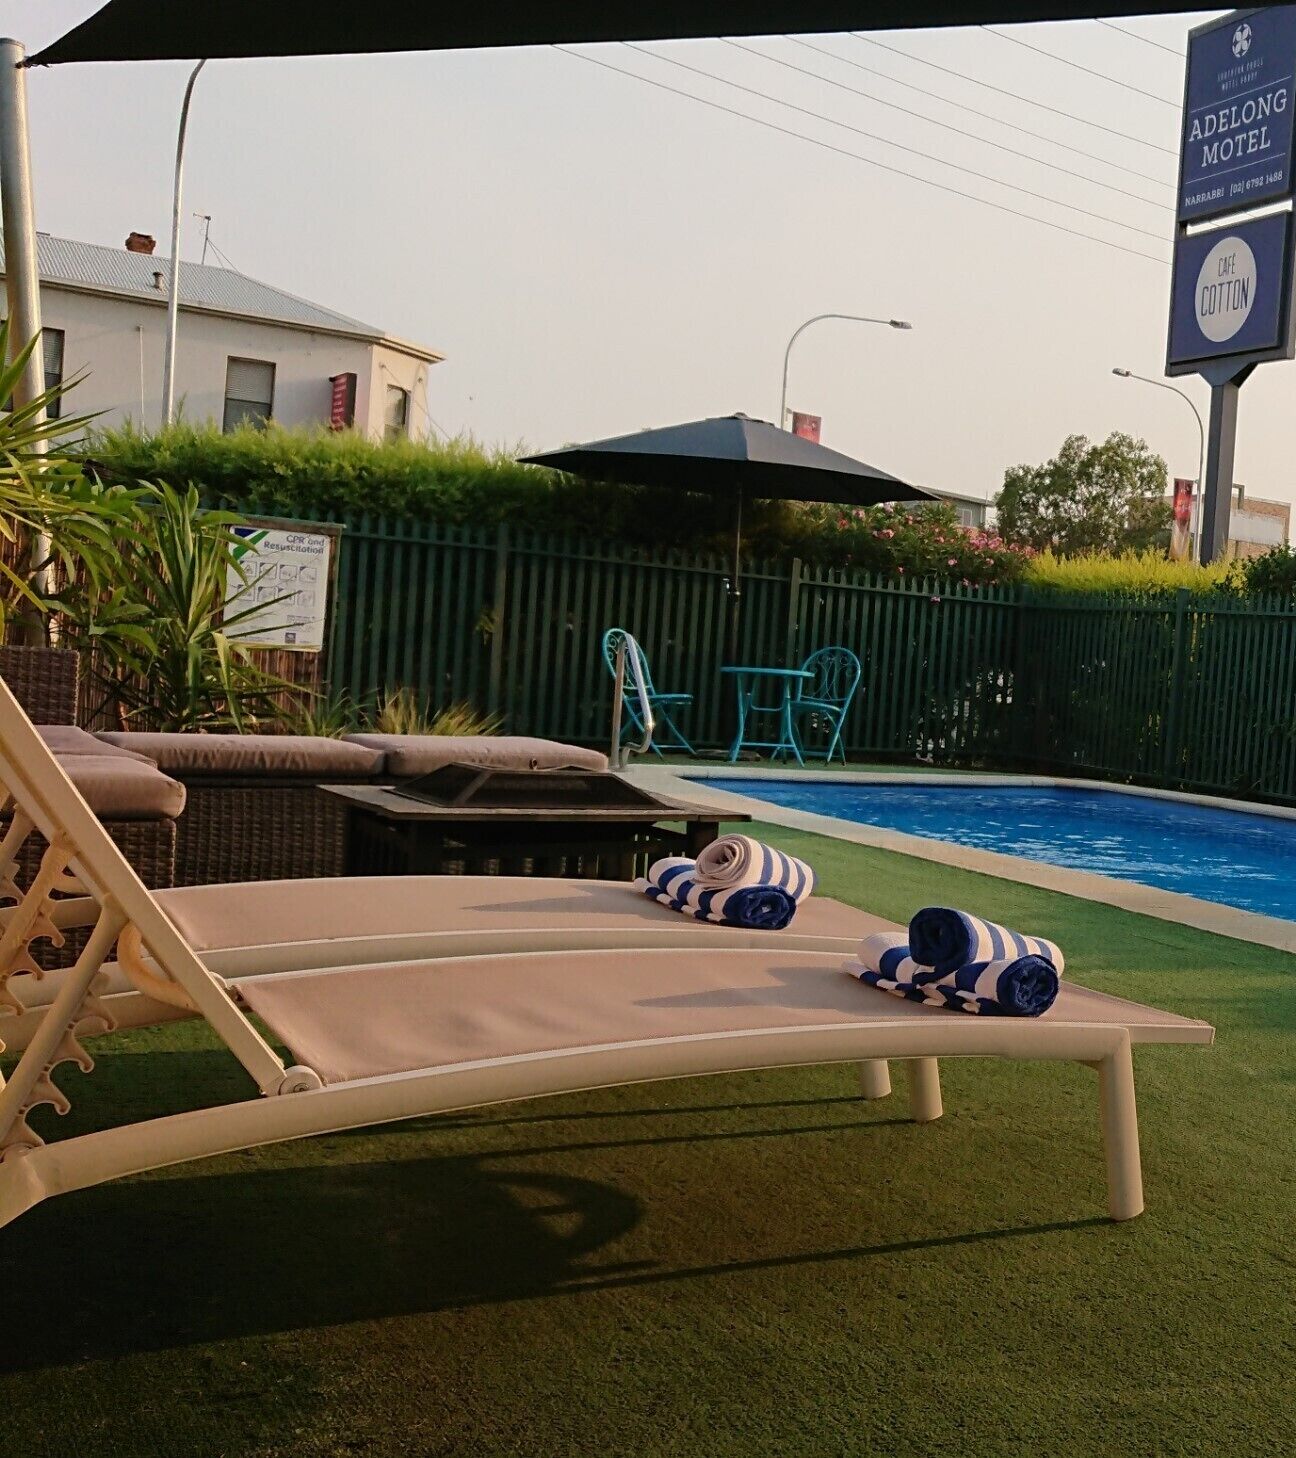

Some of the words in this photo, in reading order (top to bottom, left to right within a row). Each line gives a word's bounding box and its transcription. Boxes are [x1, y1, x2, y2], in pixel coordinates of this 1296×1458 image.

[1189, 88, 1288, 142] ADELONG
[1201, 126, 1271, 168] MOTEL
[1246, 176, 1264, 190] 6792
[1201, 276, 1250, 317] COTTON
[263, 541, 324, 554] Resuscitation
[286, 534, 305, 544] CPR
[307, 538, 325, 547] and
